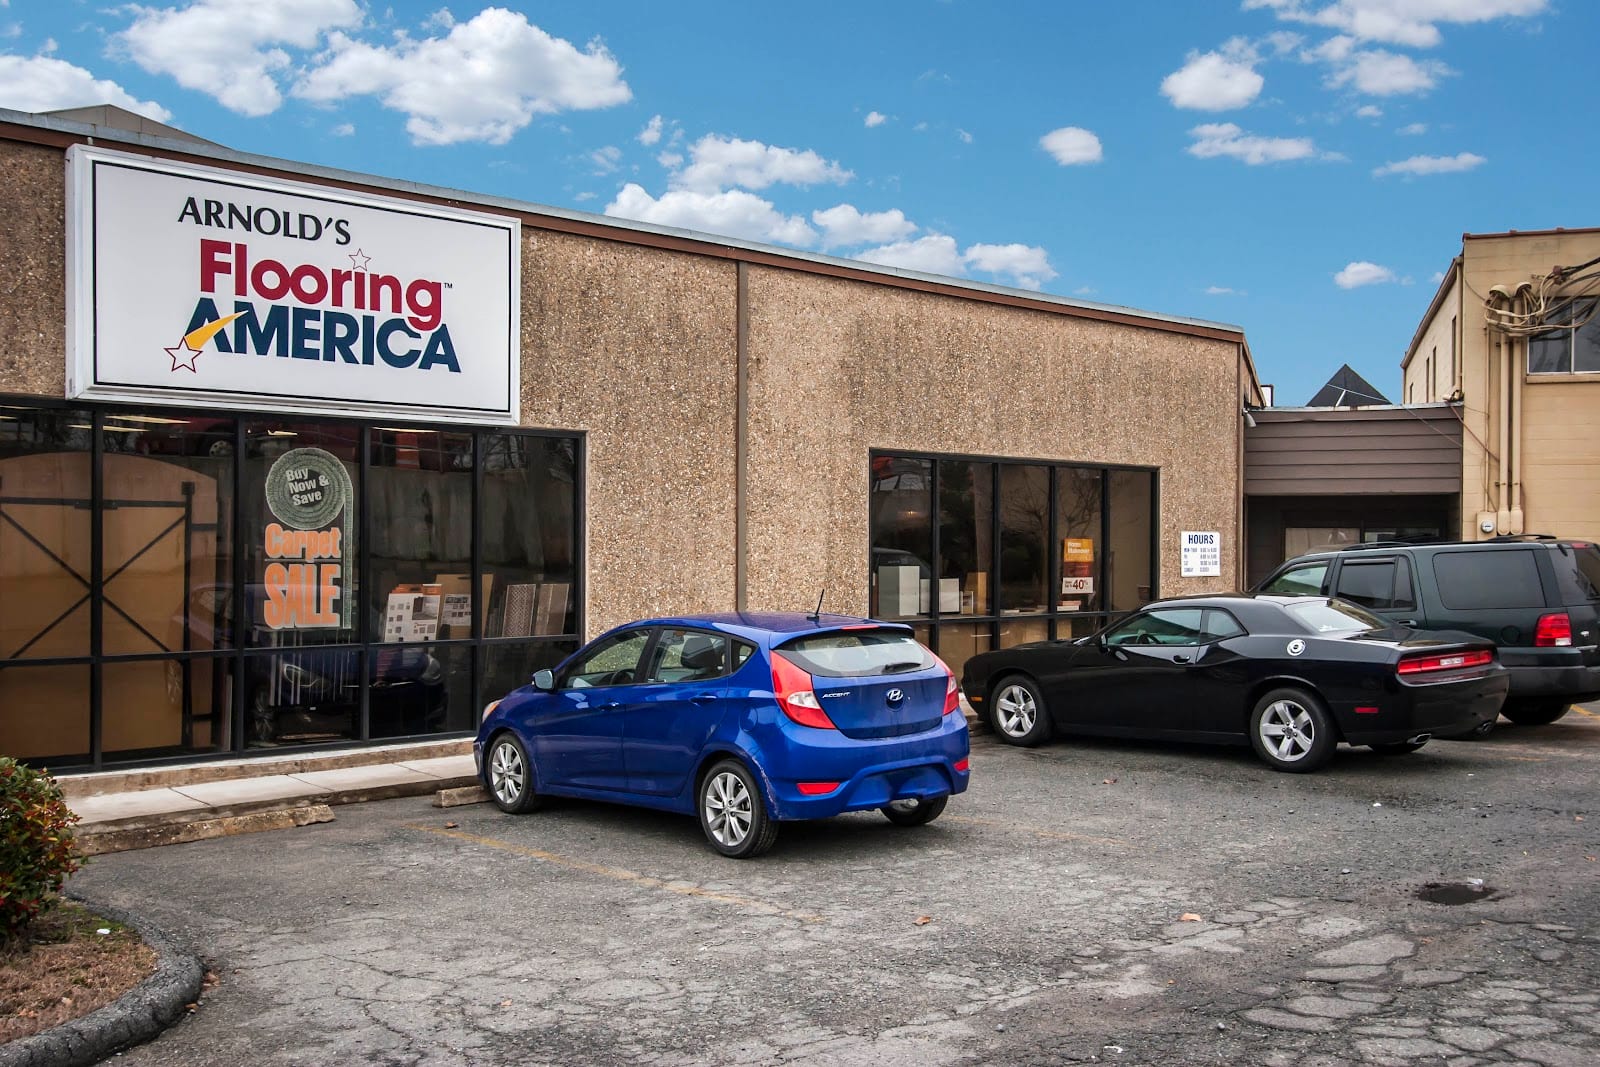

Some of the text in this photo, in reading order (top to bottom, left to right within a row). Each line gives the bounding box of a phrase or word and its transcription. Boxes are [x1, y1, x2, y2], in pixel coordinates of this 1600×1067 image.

[178, 196, 352, 246] ARNOLD'S
[200, 238, 442, 331] Flooring
[183, 297, 462, 373] AMERICA
[285, 467, 309, 482] Buy
[288, 474, 330, 495] Now &
[292, 489, 323, 507] Save
[265, 523, 342, 563] Carpet
[1188, 534, 1214, 545] HOURS
[264, 562, 341, 629] SALE
